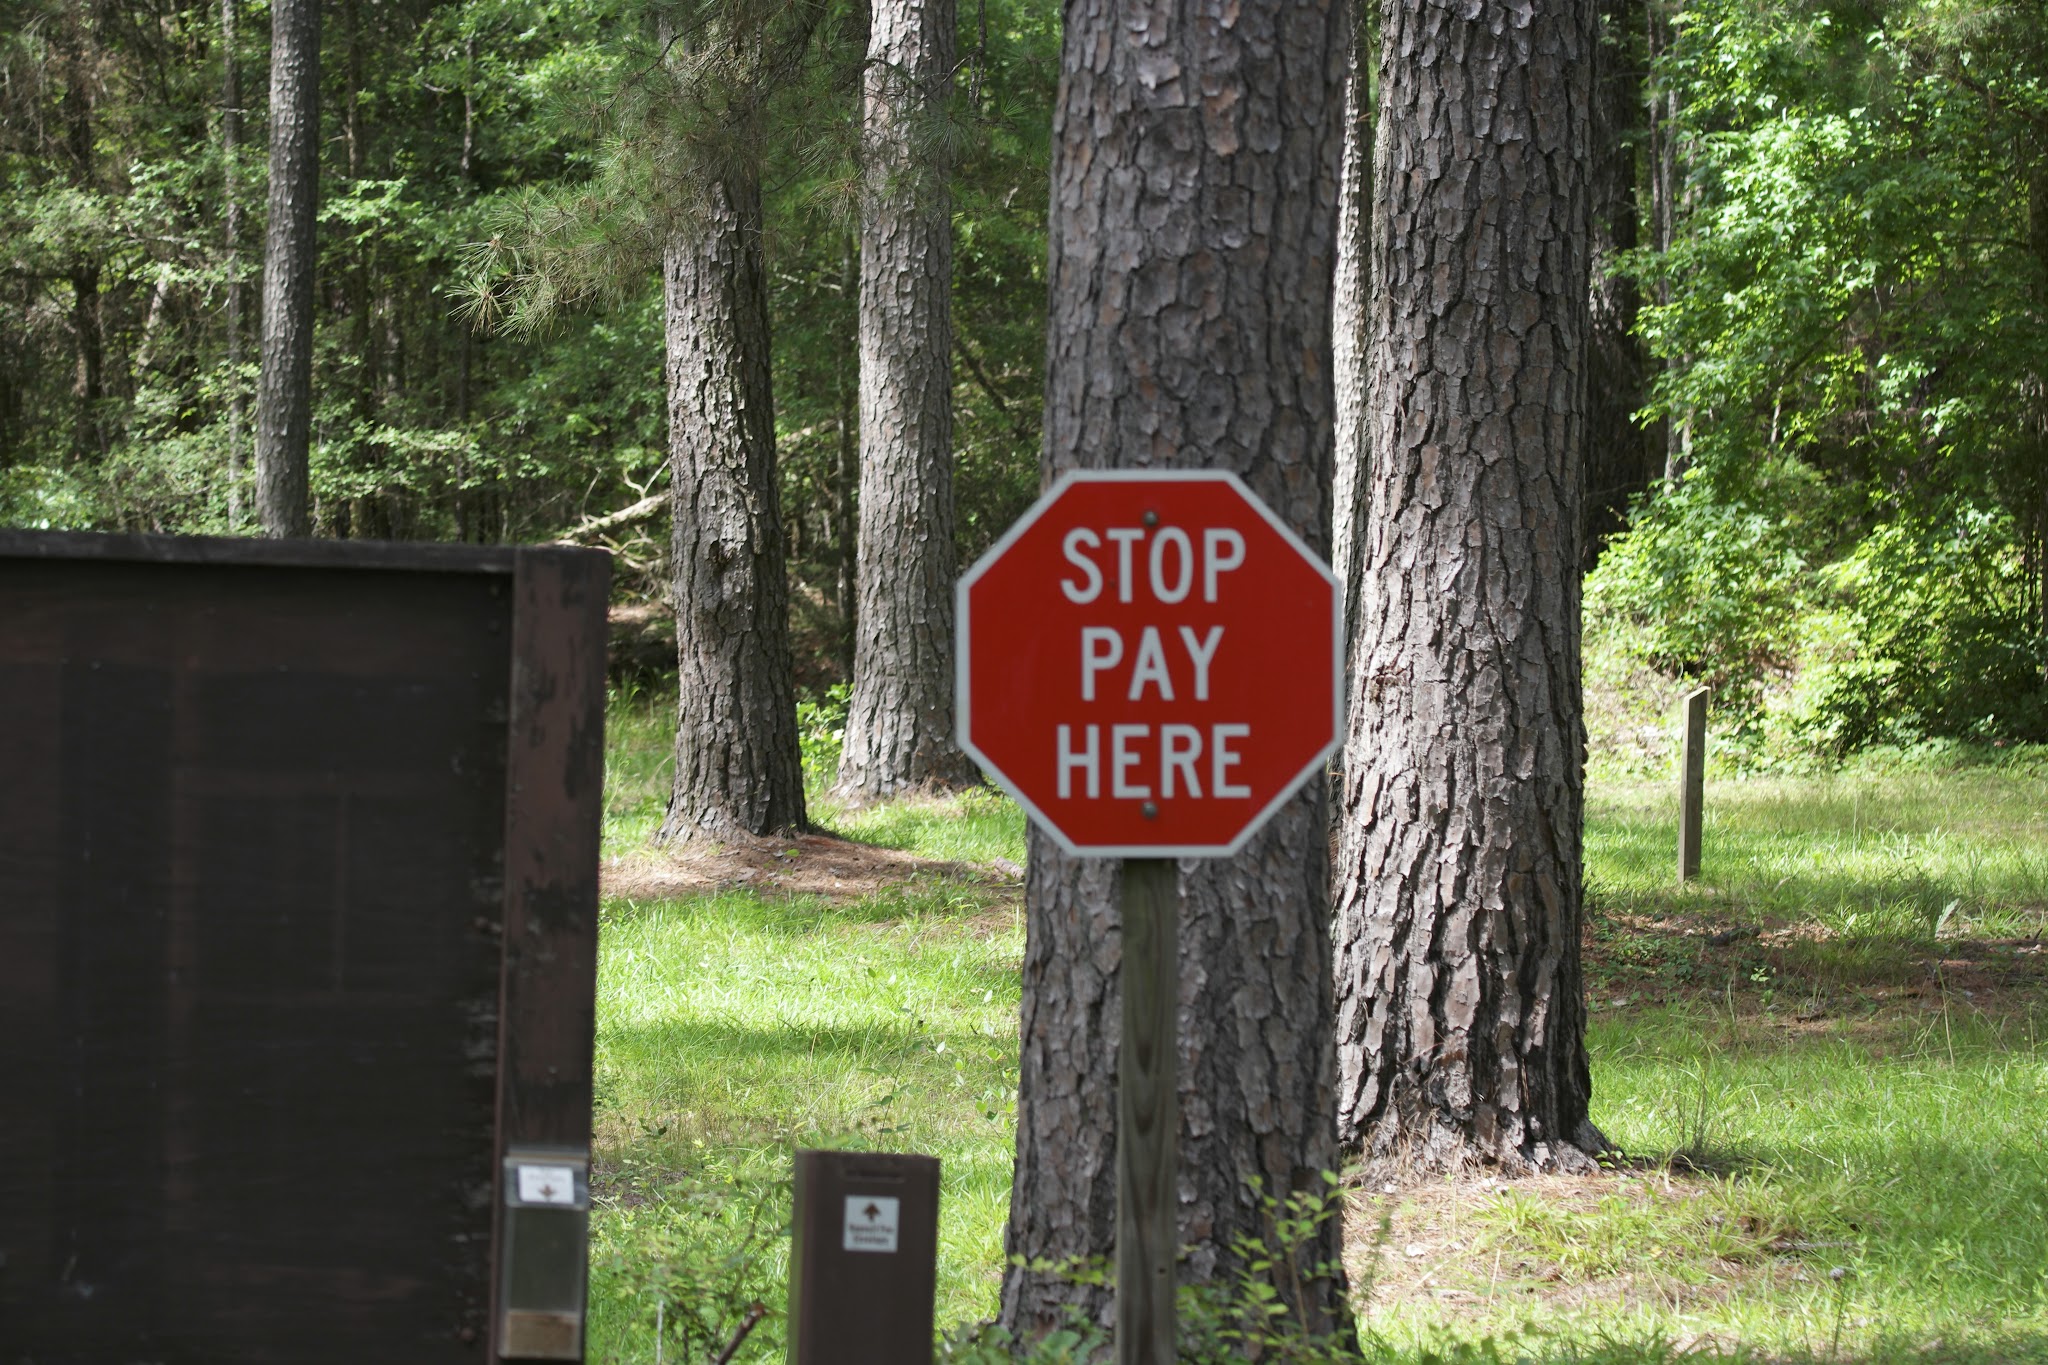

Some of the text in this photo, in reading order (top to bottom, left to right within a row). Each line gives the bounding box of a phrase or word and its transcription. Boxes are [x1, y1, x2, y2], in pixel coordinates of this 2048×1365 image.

[1061, 527, 1246, 604] STOP
[1081, 626, 1224, 701] PAY
[1057, 723, 1251, 799] HERE
